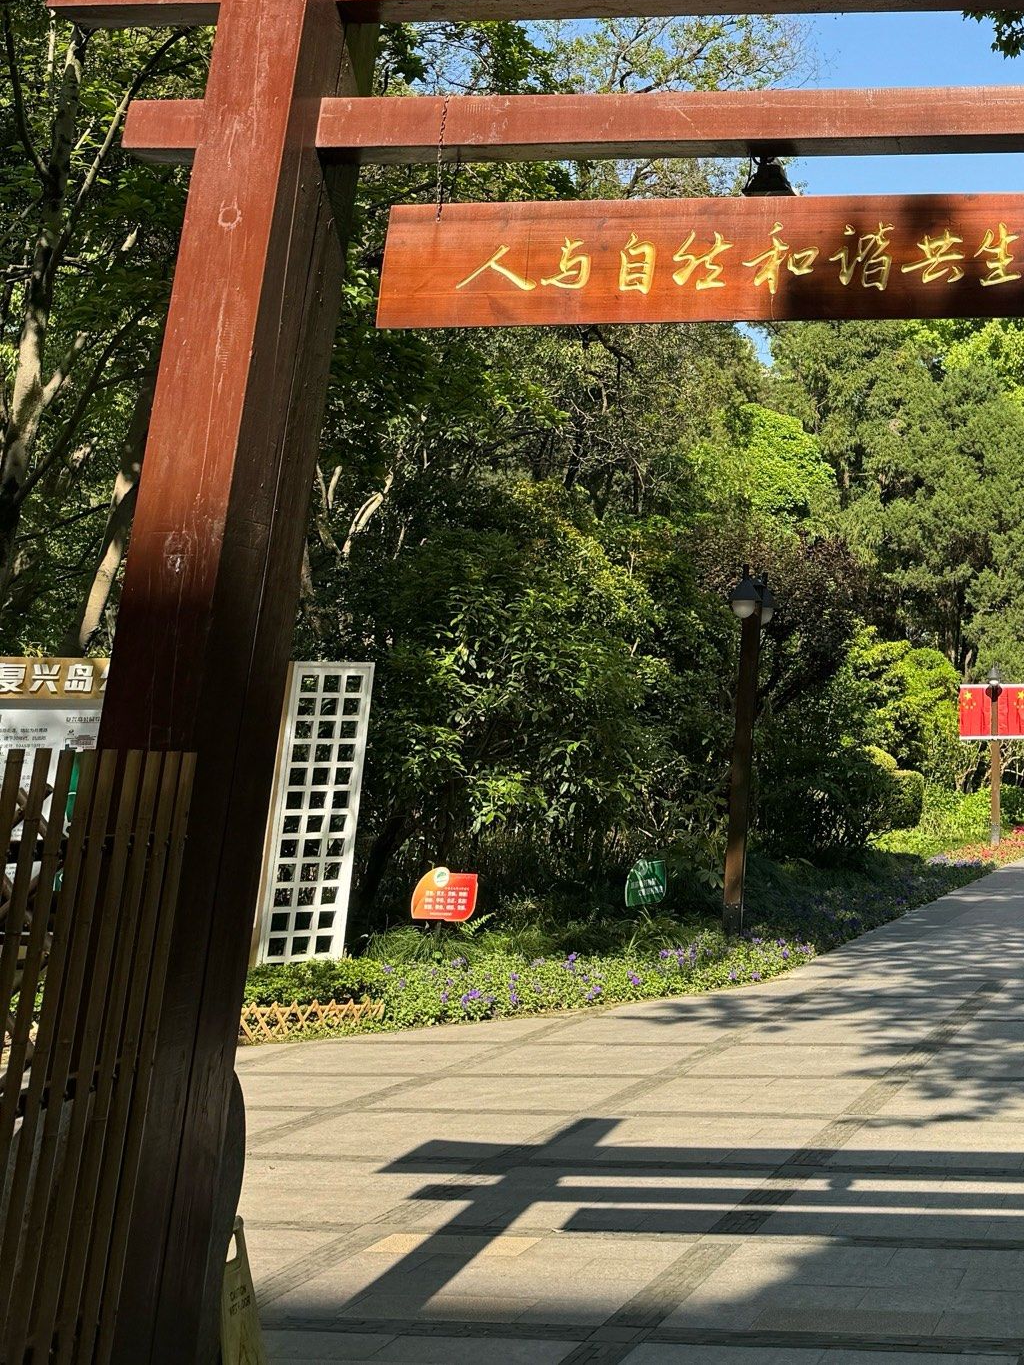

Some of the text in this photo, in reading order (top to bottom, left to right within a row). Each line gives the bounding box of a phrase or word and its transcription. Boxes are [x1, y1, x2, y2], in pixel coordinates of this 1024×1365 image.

[455, 221, 1023, 296] 人与自然和谐共生
